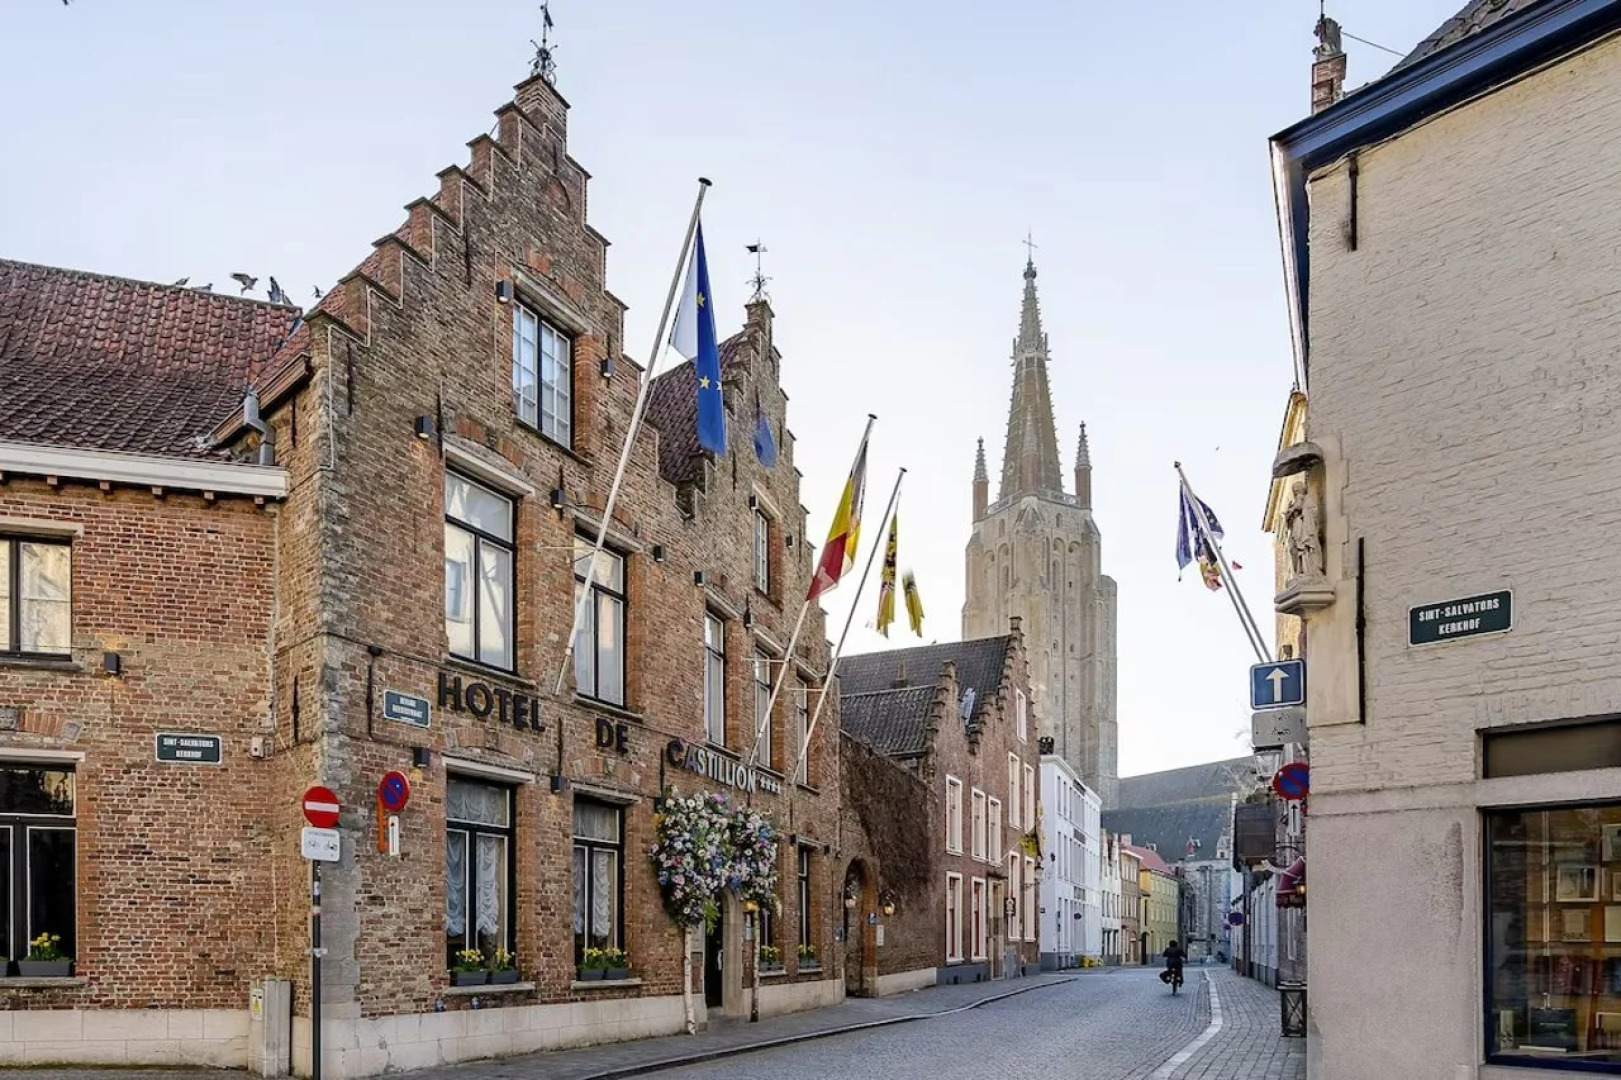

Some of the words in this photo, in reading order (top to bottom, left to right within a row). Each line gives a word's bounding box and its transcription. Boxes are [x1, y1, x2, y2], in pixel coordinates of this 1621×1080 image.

[1419, 598, 1499, 621] SINT-SALVATORS
[1438, 618, 1480, 634] KERKHOF
[438, 672, 545, 732] HOTEL
[596, 718, 628, 752] DE
[667, 741, 756, 794] CASTILLION
